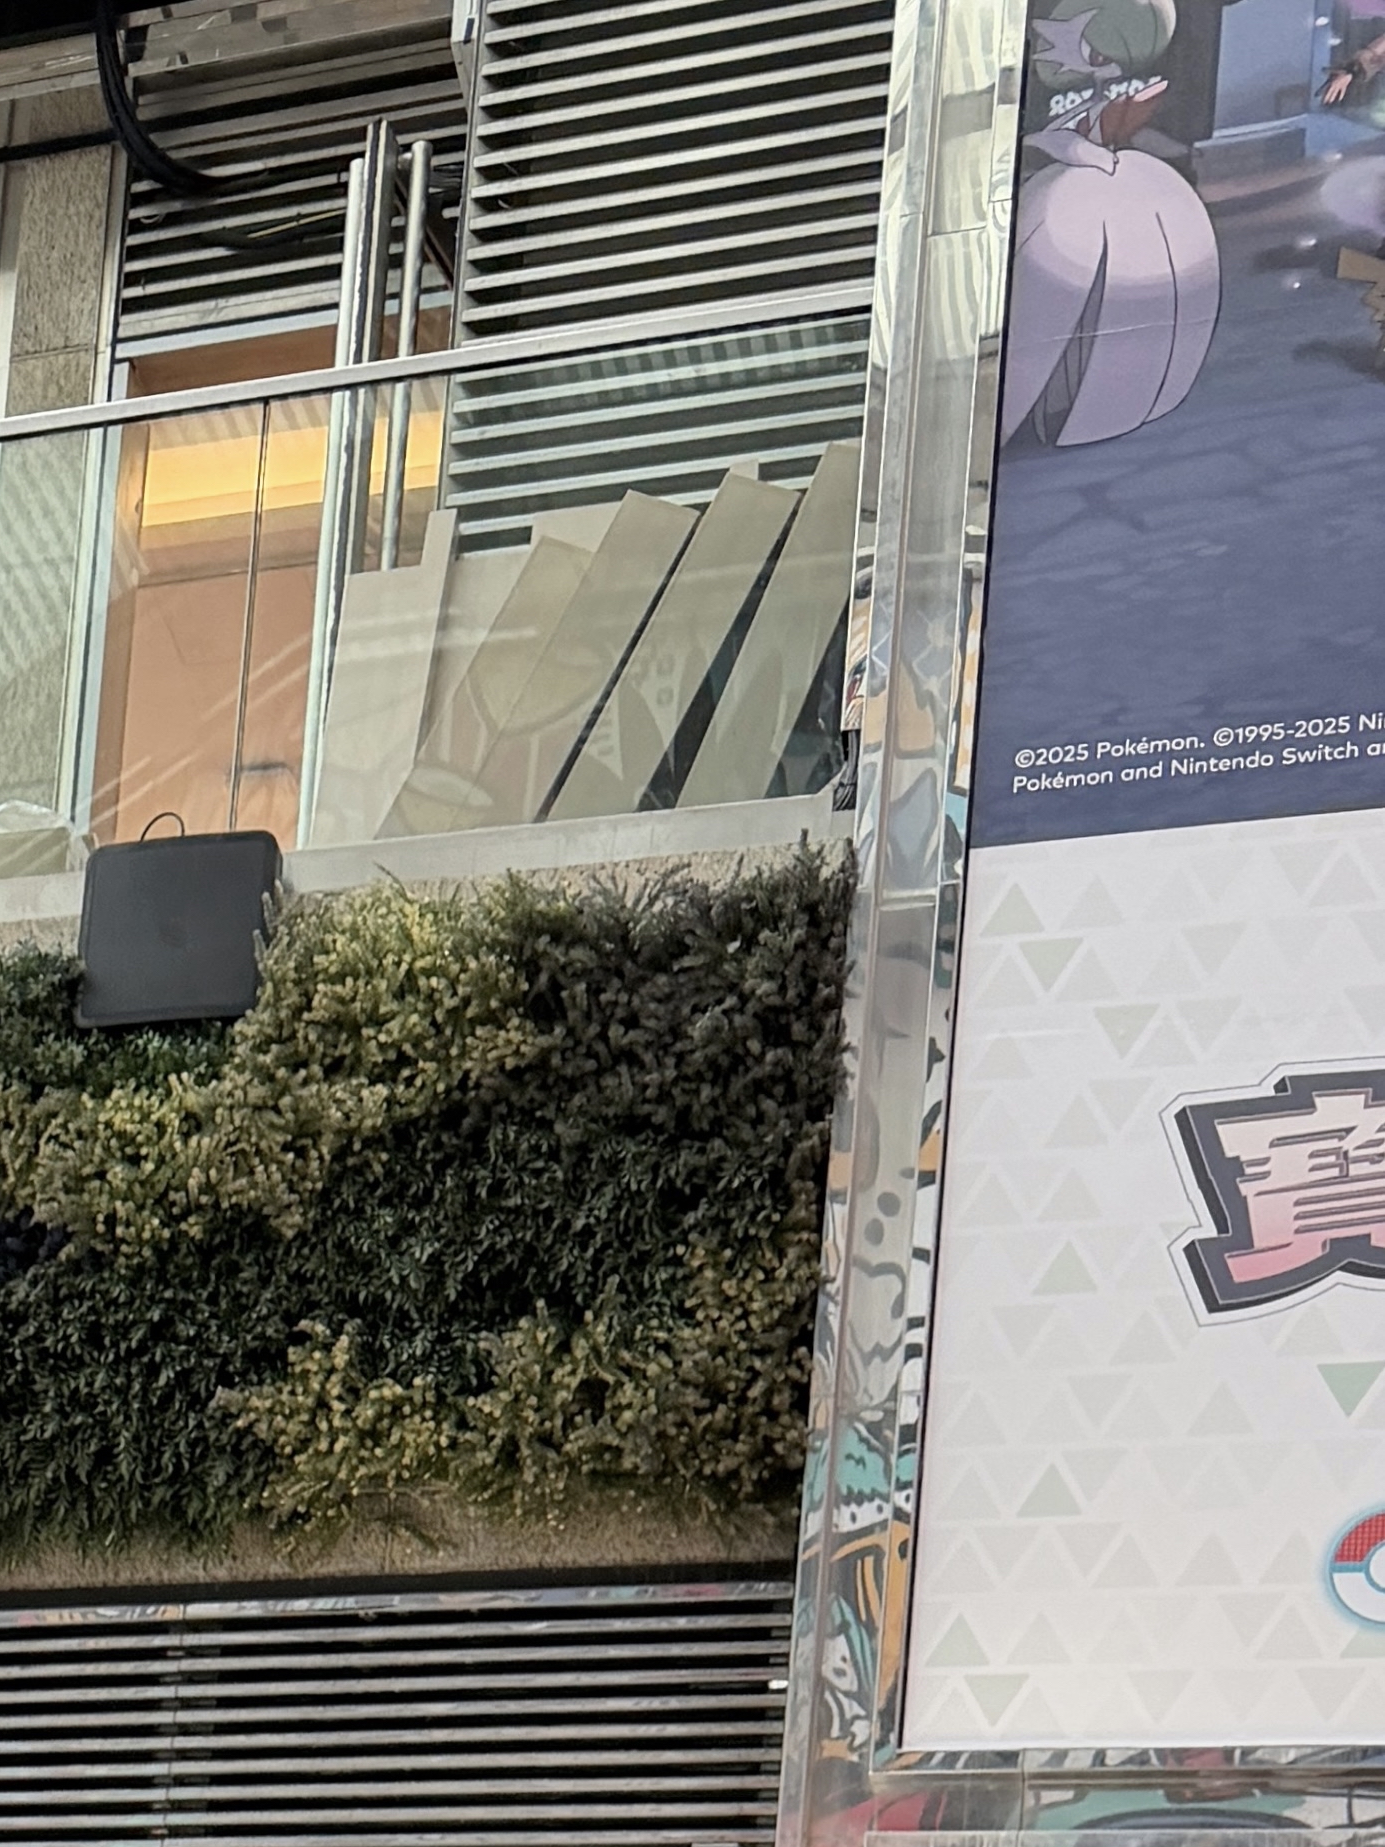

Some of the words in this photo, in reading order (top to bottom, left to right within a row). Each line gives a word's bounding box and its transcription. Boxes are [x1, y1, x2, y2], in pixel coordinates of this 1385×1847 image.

[1012, 769, 1114, 793] Pokémon
[1120, 760, 1163, 781] and
[1171, 750, 1274, 777] Nintendo
[1282, 740, 1360, 765] Switch
[1367, 743, 1385, 756] a
[1014, 743, 1089, 768] ©2025
[1096, 736, 1206, 760] Pokémon.
[1213, 715, 1351, 747] ©1995-2025
[1358, 712, 1385, 732] Ni
